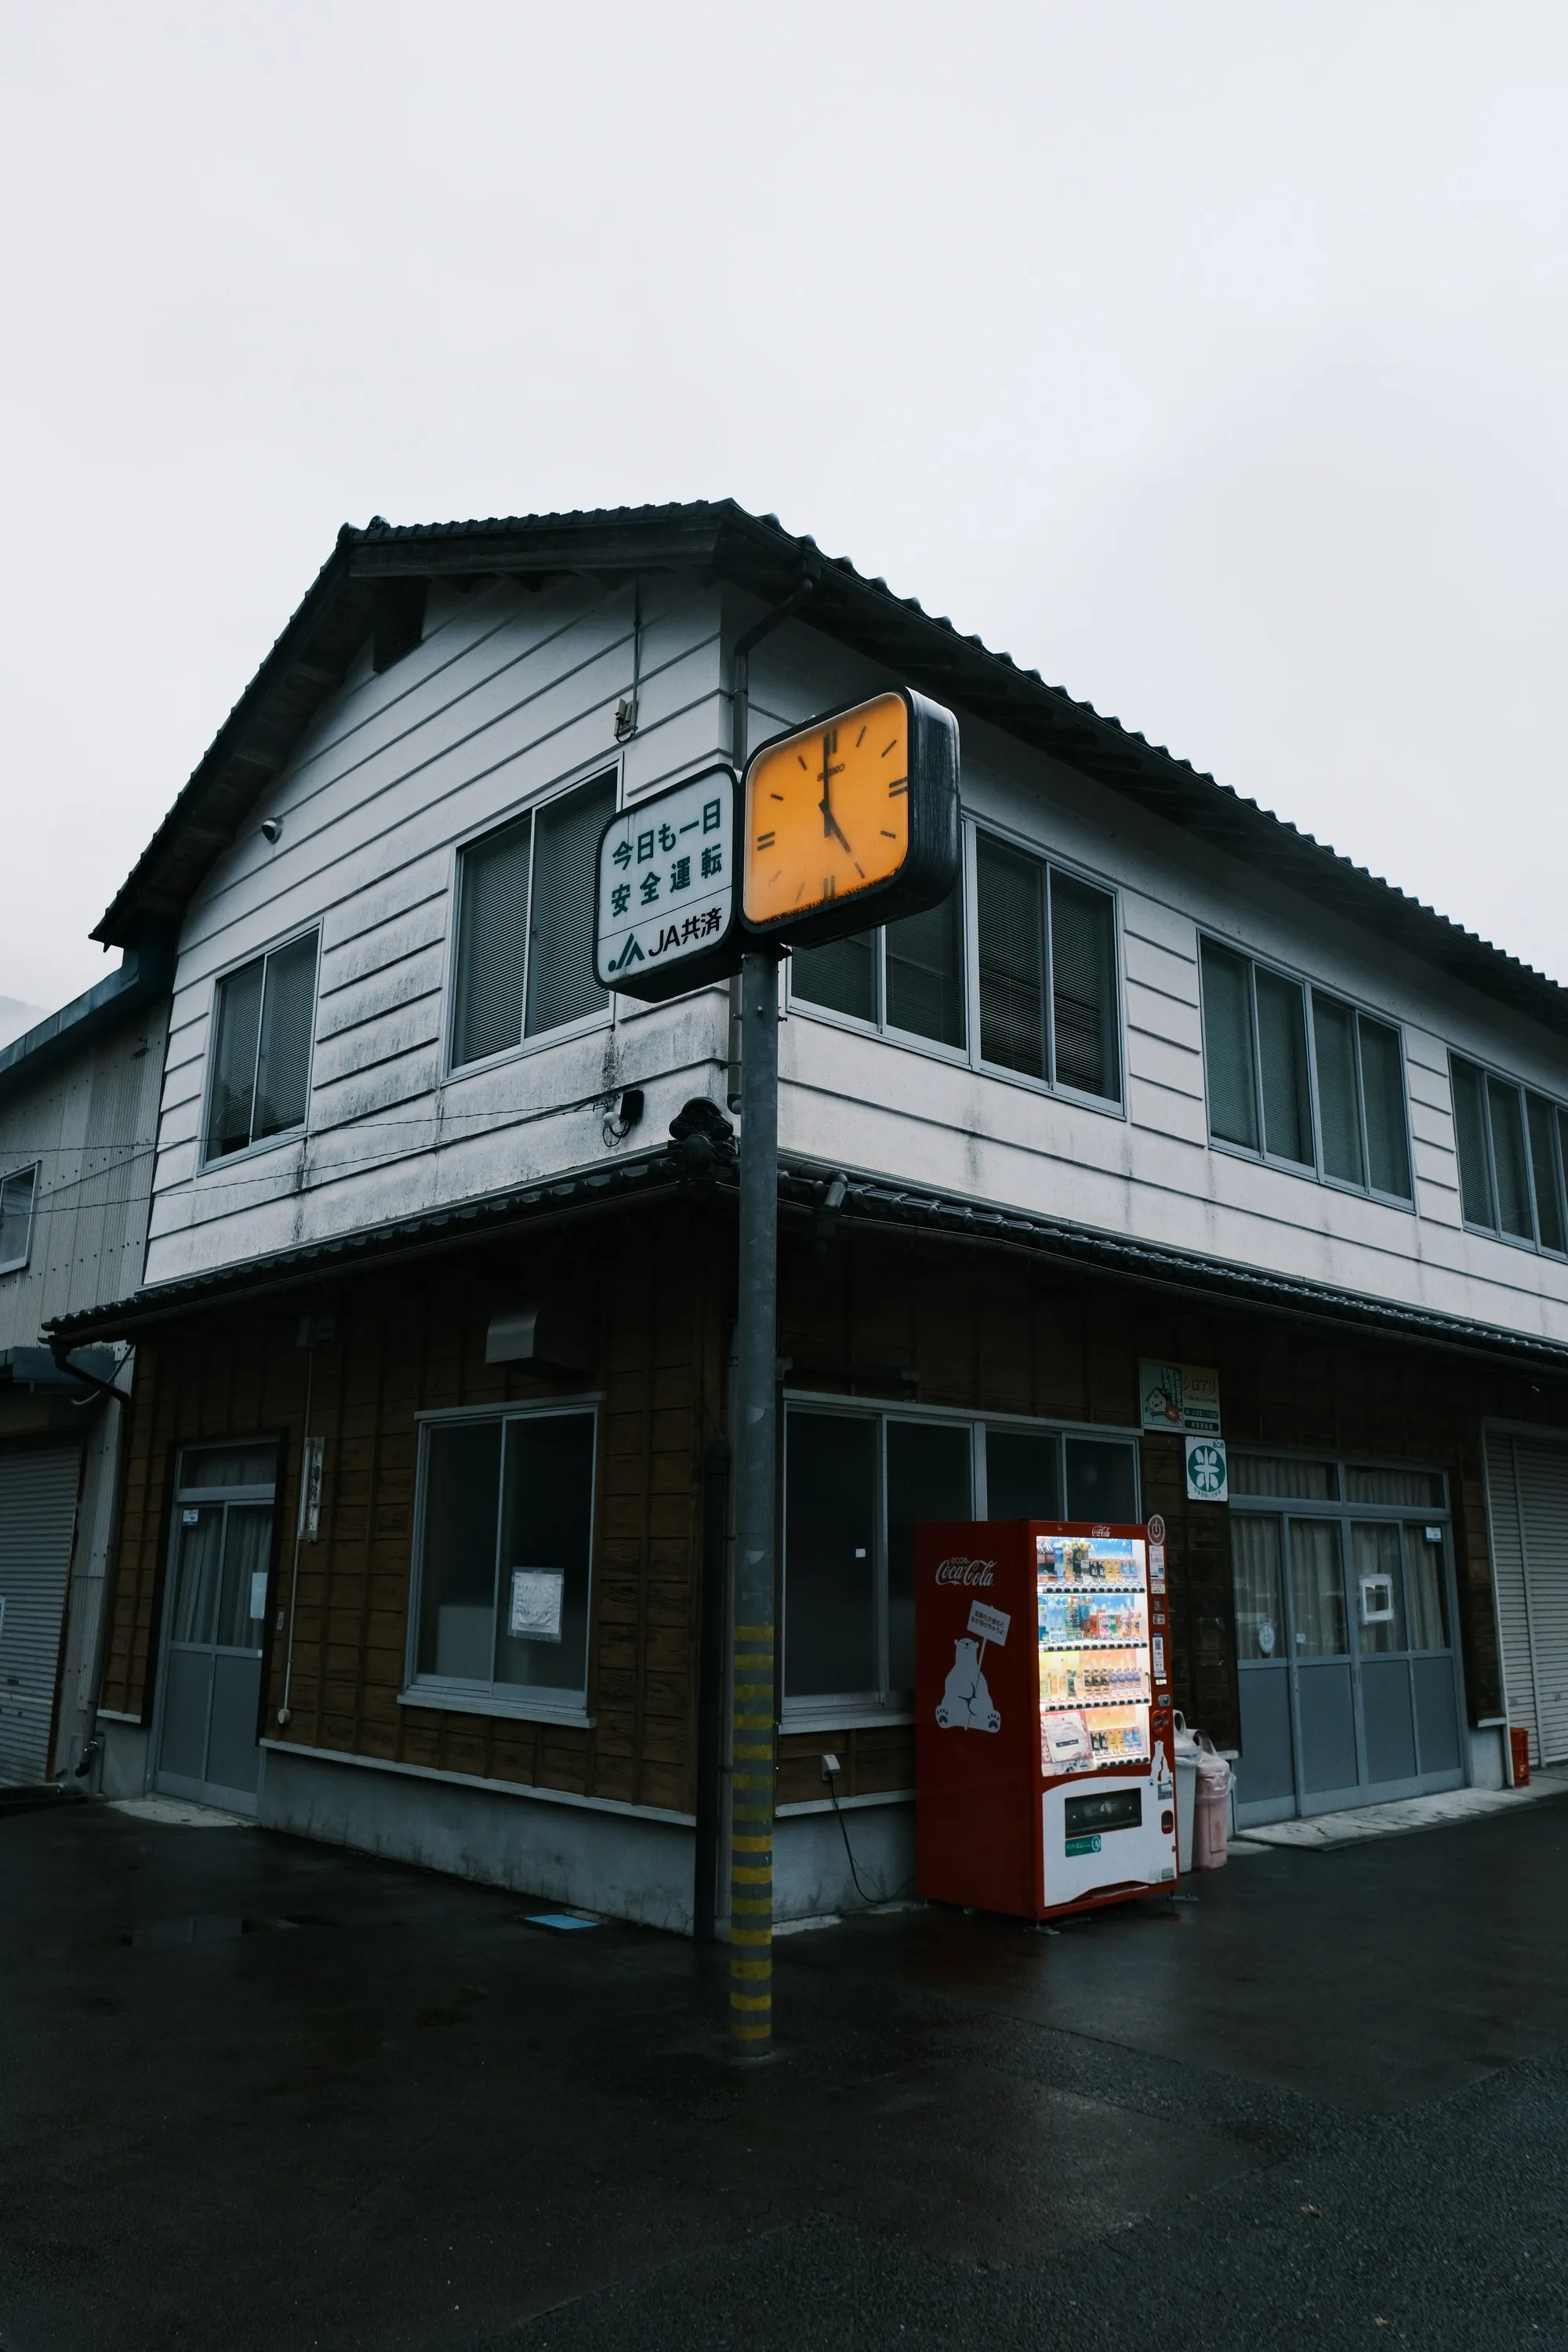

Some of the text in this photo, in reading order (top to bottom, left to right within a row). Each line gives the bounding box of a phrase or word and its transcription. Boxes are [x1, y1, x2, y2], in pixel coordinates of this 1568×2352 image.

[817, 763, 846, 782] SIKO
[612, 798, 720, 871] 今日も一日
[612, 843, 722, 917] 安全運転
[648, 907, 722, 956] JA共済
[1183, 1376, 1216, 1395] シロアリ
[935, 1559, 998, 1587] Coca-Cola
